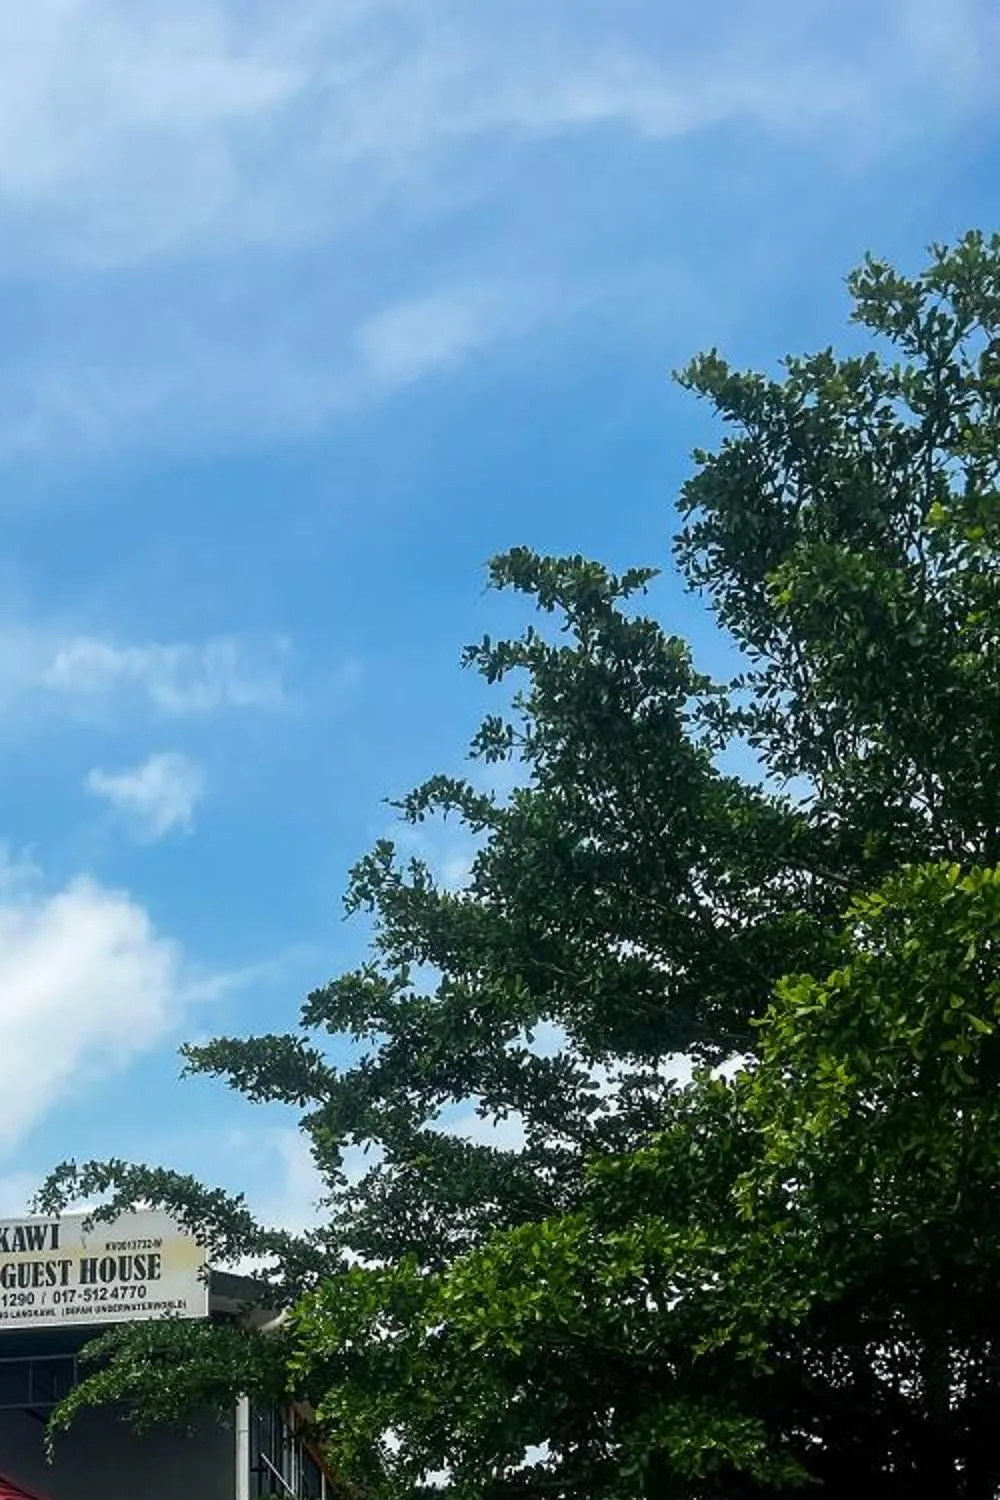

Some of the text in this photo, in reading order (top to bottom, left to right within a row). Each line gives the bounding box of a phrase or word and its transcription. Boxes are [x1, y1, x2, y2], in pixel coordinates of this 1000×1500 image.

[0, 1258, 73, 1290] GUEST
[80, 1253, 161, 1284] HOUSE
[53, 1285, 147, 1304] 017-5124770
